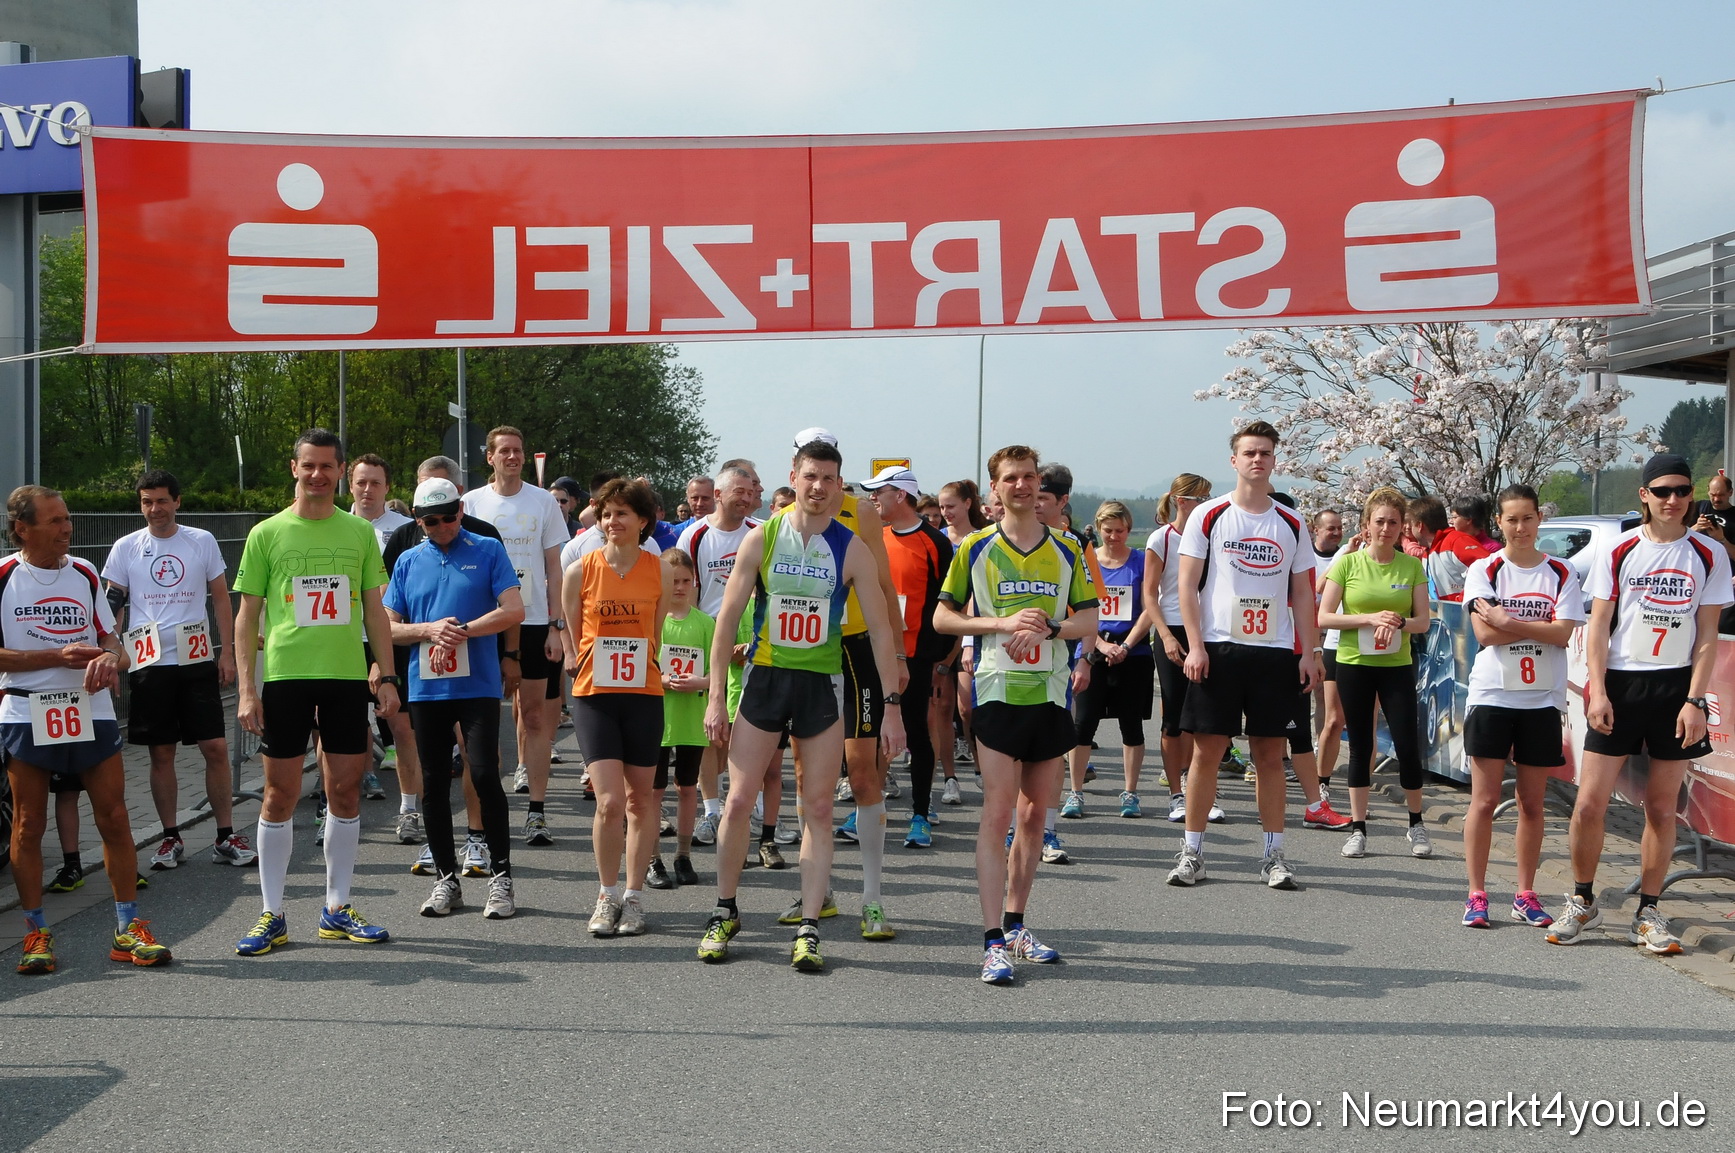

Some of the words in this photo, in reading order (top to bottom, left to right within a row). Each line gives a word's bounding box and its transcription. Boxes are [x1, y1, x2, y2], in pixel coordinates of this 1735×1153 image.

[0, 101, 92, 148] VO
[1223, 541, 1274, 554] GERHART
[773, 562, 829, 579] BOCK
[998, 580, 1059, 597] BOCK
[1628, 578, 1686, 587] GERHART
[14, 606, 79, 616] GERHART
[307, 591, 338, 620] 74
[600, 603, 640, 617] OEXL
[780, 598, 808, 606] MEYER
[1101, 596, 1119, 616] 31
[1242, 609, 1268, 635] 33
[1643, 614, 1670, 622] MEYER
[26, 629, 39, 639] Das
[40, 636, 68, 644] sportliche
[69, 636, 89, 644] Autoha
[128, 629, 144, 638] MEYER
[778, 612, 822, 644] 100
[135, 636, 155, 664] 24
[188, 634, 208, 660] 23
[1652, 628, 1668, 656] 7
[1014, 644, 1040, 664] 0
[610, 653, 635, 682] 15
[670, 658, 694, 677] 34
[1520, 657, 1536, 684] 8
[40, 692, 69, 701] MEYER
[862, 688, 871, 723] SKINS
[46, 706, 82, 739] 66
[1708, 731, 1730, 743] EAT
